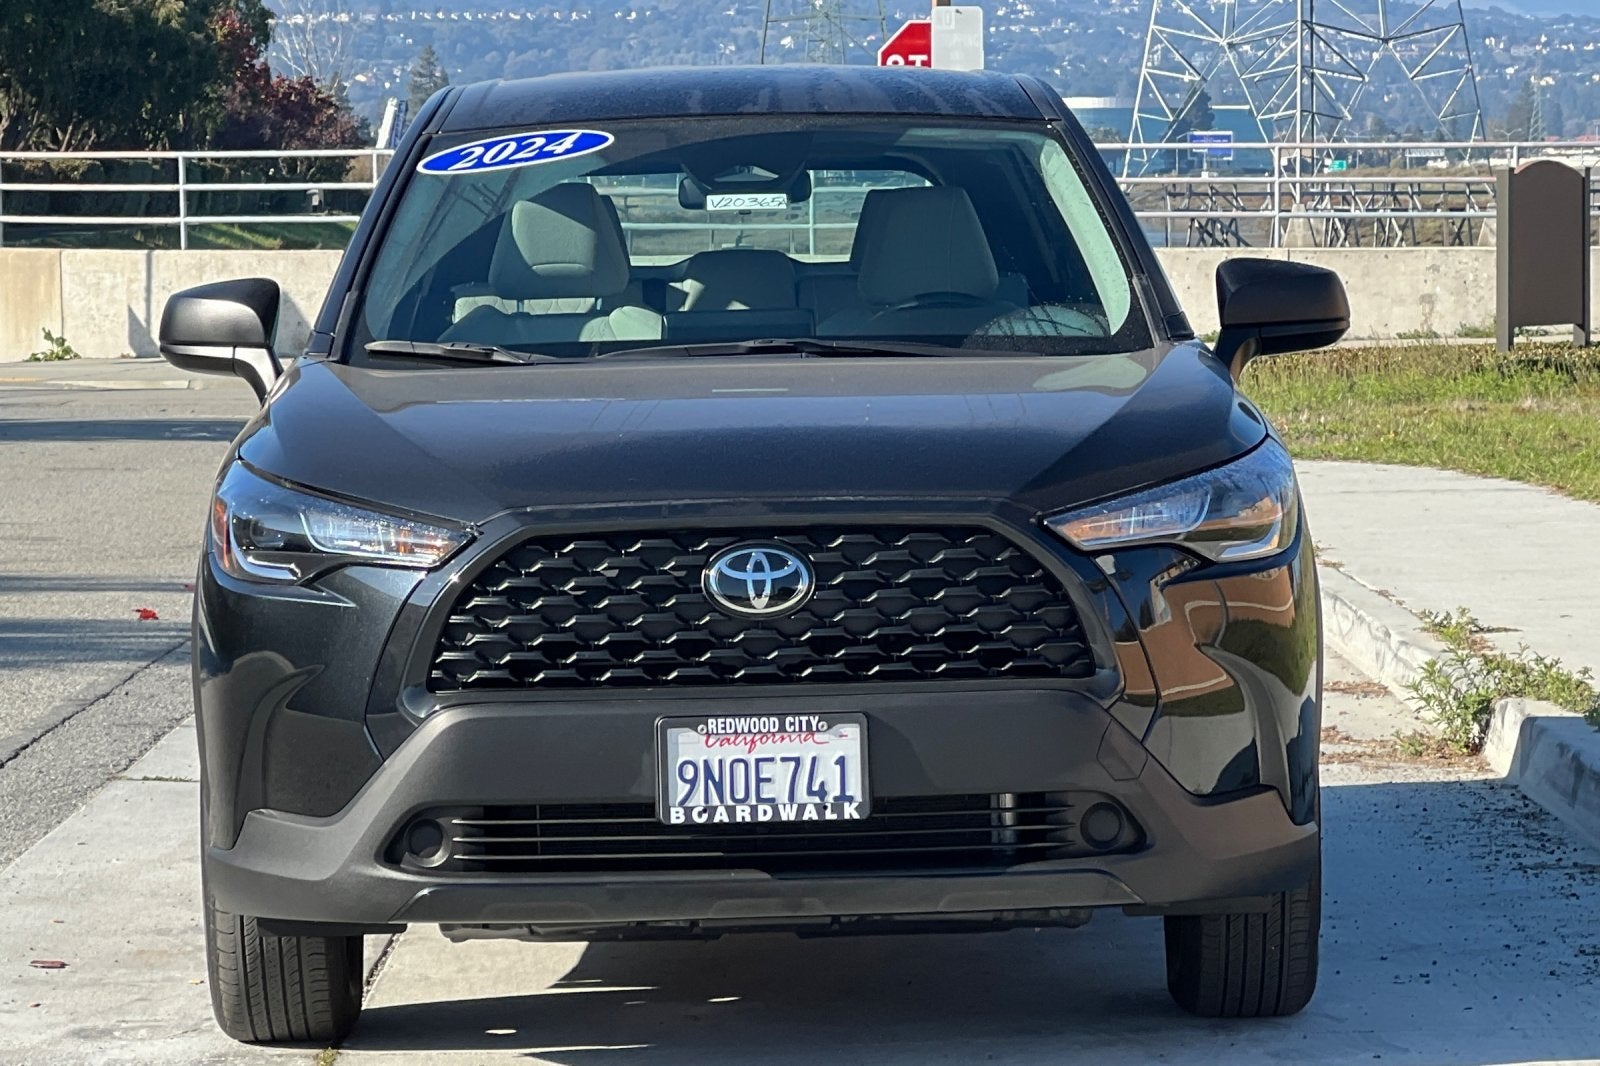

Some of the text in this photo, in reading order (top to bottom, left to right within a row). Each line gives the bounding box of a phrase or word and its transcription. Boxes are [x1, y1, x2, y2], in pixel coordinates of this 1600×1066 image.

[447, 132, 583, 171] 2024
[707, 715, 820, 734] REDWOOD CITY
[704, 731, 829, 754] California
[677, 754, 854, 806] 9NOE741
[670, 802, 860, 824] BOARDWALK
